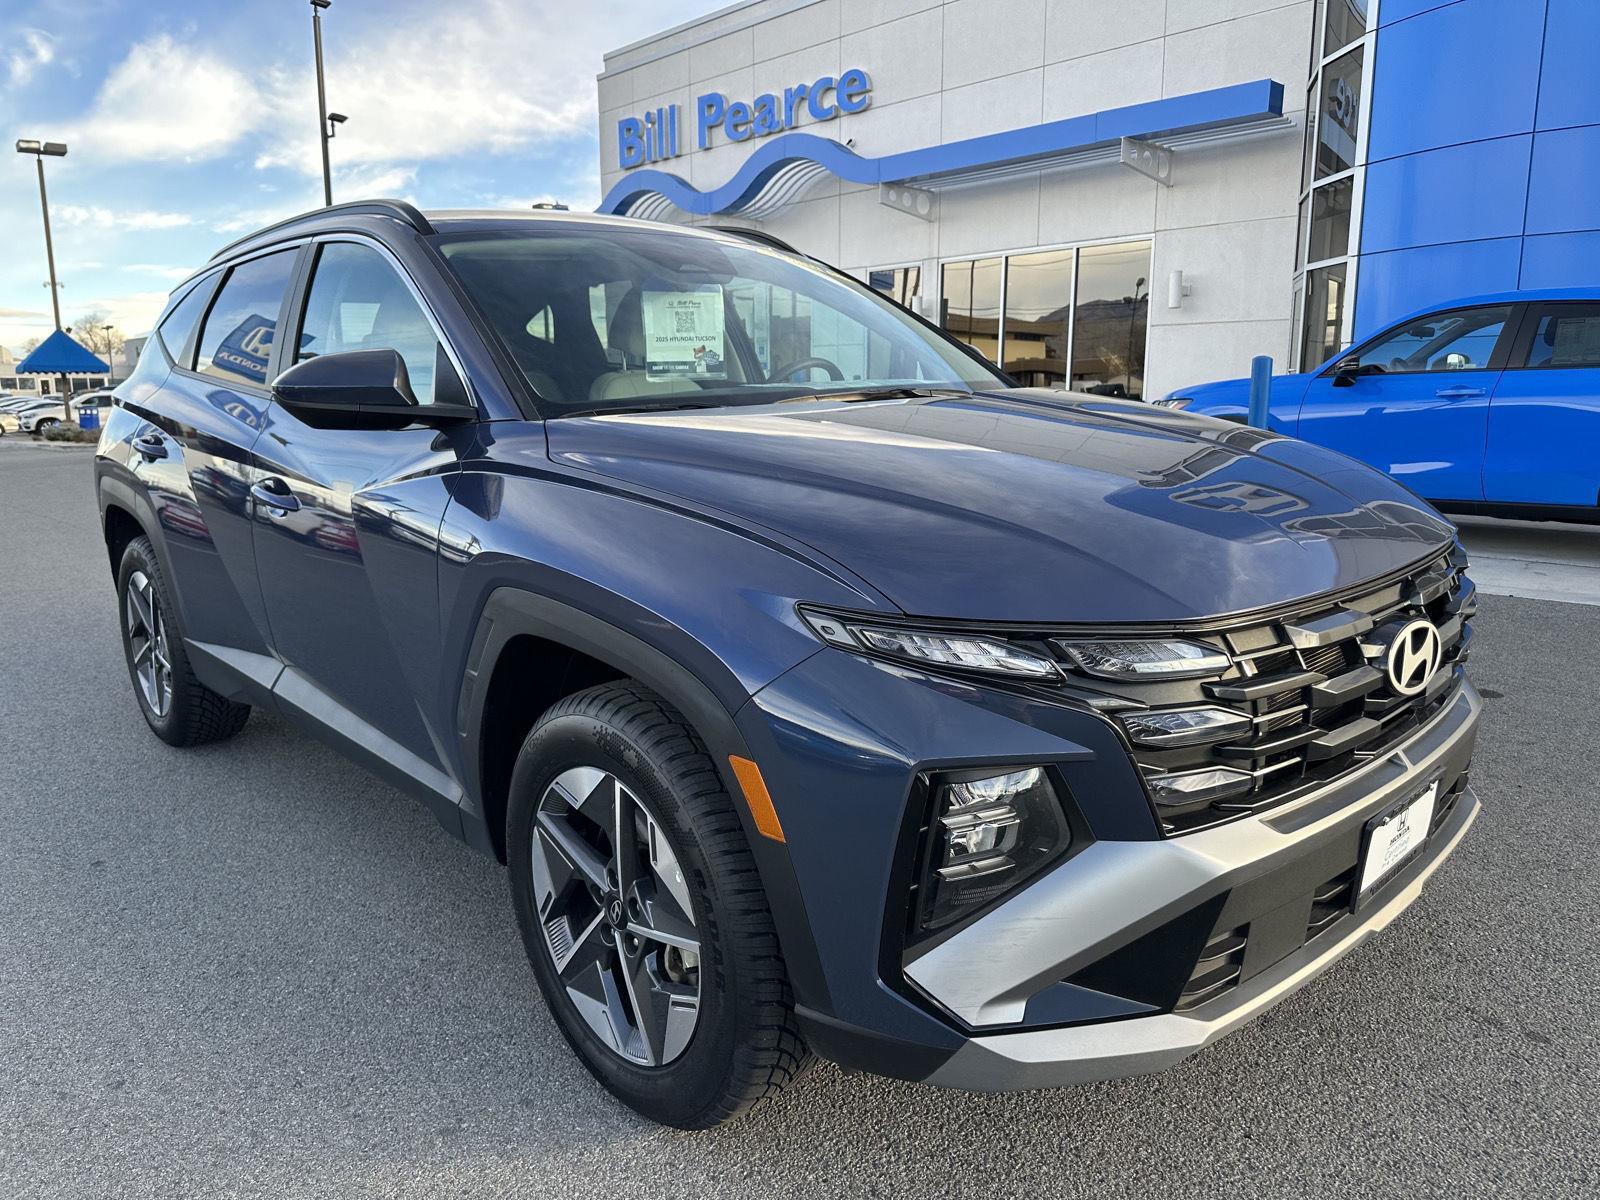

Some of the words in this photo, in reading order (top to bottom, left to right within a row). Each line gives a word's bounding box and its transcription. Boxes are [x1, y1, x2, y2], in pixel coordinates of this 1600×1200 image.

[618, 104, 680, 170] Bill
[697, 68, 872, 150] Pearce
[1389, 826, 1410, 845] HONDA
